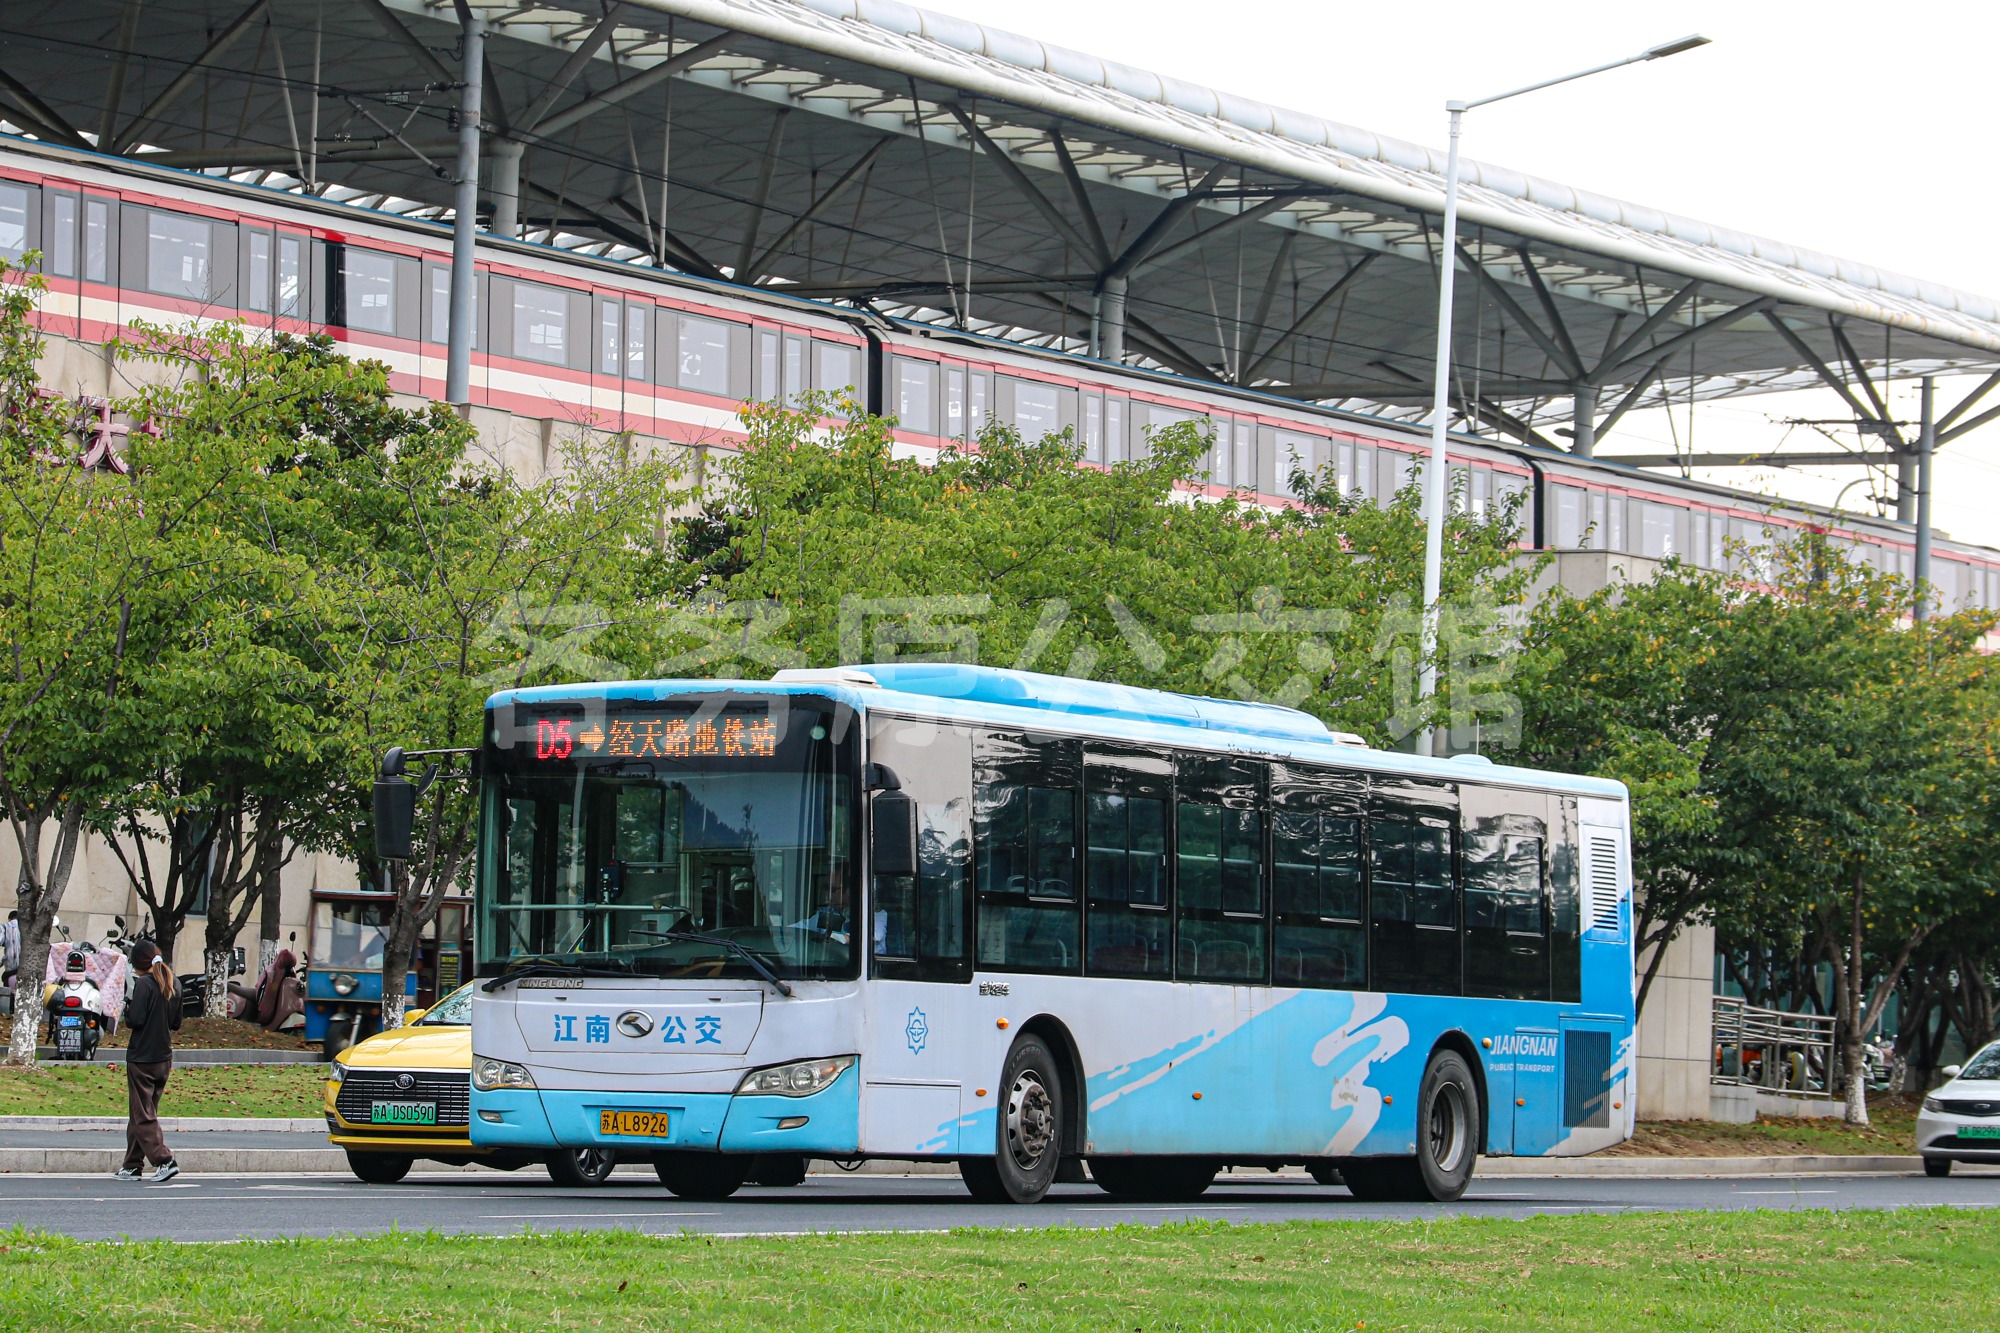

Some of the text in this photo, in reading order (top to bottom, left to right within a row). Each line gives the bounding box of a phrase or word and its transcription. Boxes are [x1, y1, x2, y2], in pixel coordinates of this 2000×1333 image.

[536, 719, 573, 759] D5
[609, 717, 777, 758] 经天路地铁站
[548, 979, 583, 988] LONG
[553, 1014, 722, 1044] 江南 公交
[1490, 1034, 1558, 1057] JIANGNAN
[1489, 1063, 1555, 1073] PUBLIC TRANSPORT
